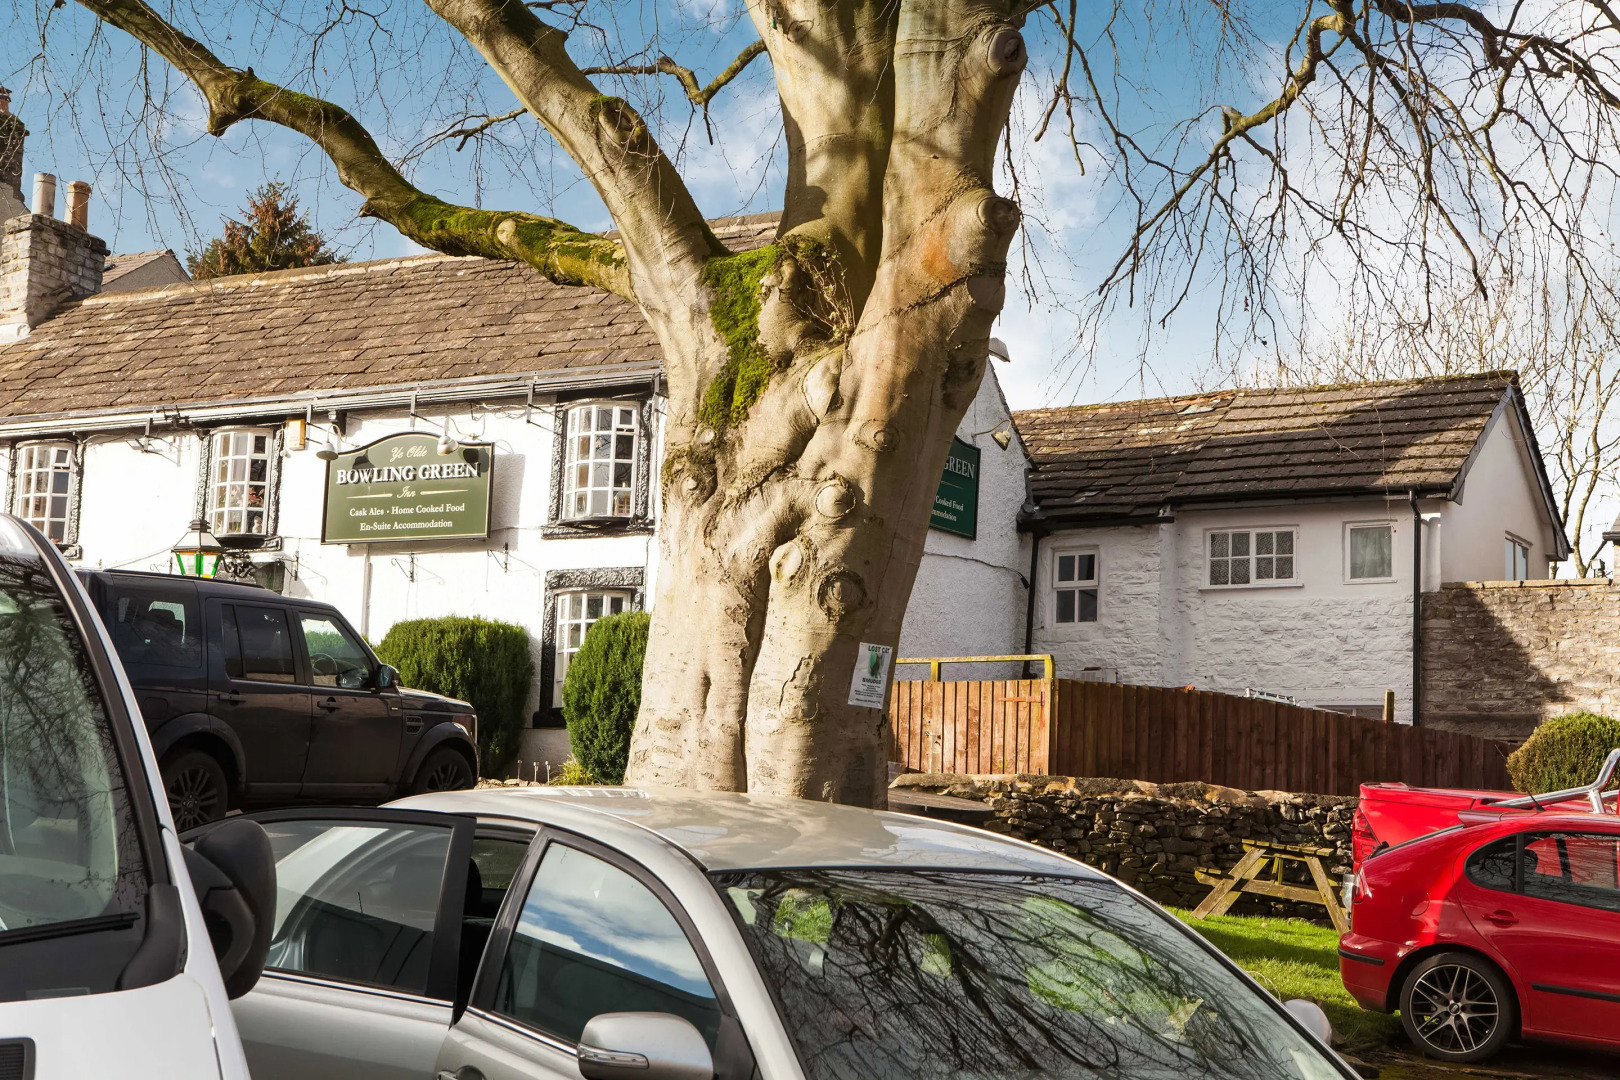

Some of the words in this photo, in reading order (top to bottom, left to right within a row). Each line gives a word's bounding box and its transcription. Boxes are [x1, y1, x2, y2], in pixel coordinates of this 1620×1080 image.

[391, 447, 404, 462] Ye
[406, 445, 427, 459] Olde
[336, 465, 417, 485] BOWLING
[418, 462, 480, 481] GREEN
[396, 486, 416, 498] Inn
[349, 507, 367, 517] Cask
[368, 505, 385, 516] Ales
[391, 505, 414, 515] Home
[416, 503, 444, 514] Cooked
[445, 502, 465, 512] Food
[936, 496, 952, 507] Cooked
[953, 500, 964, 511] Food
[360, 520, 391, 531] En-Suite
[392, 519, 453, 530] Accommodation
